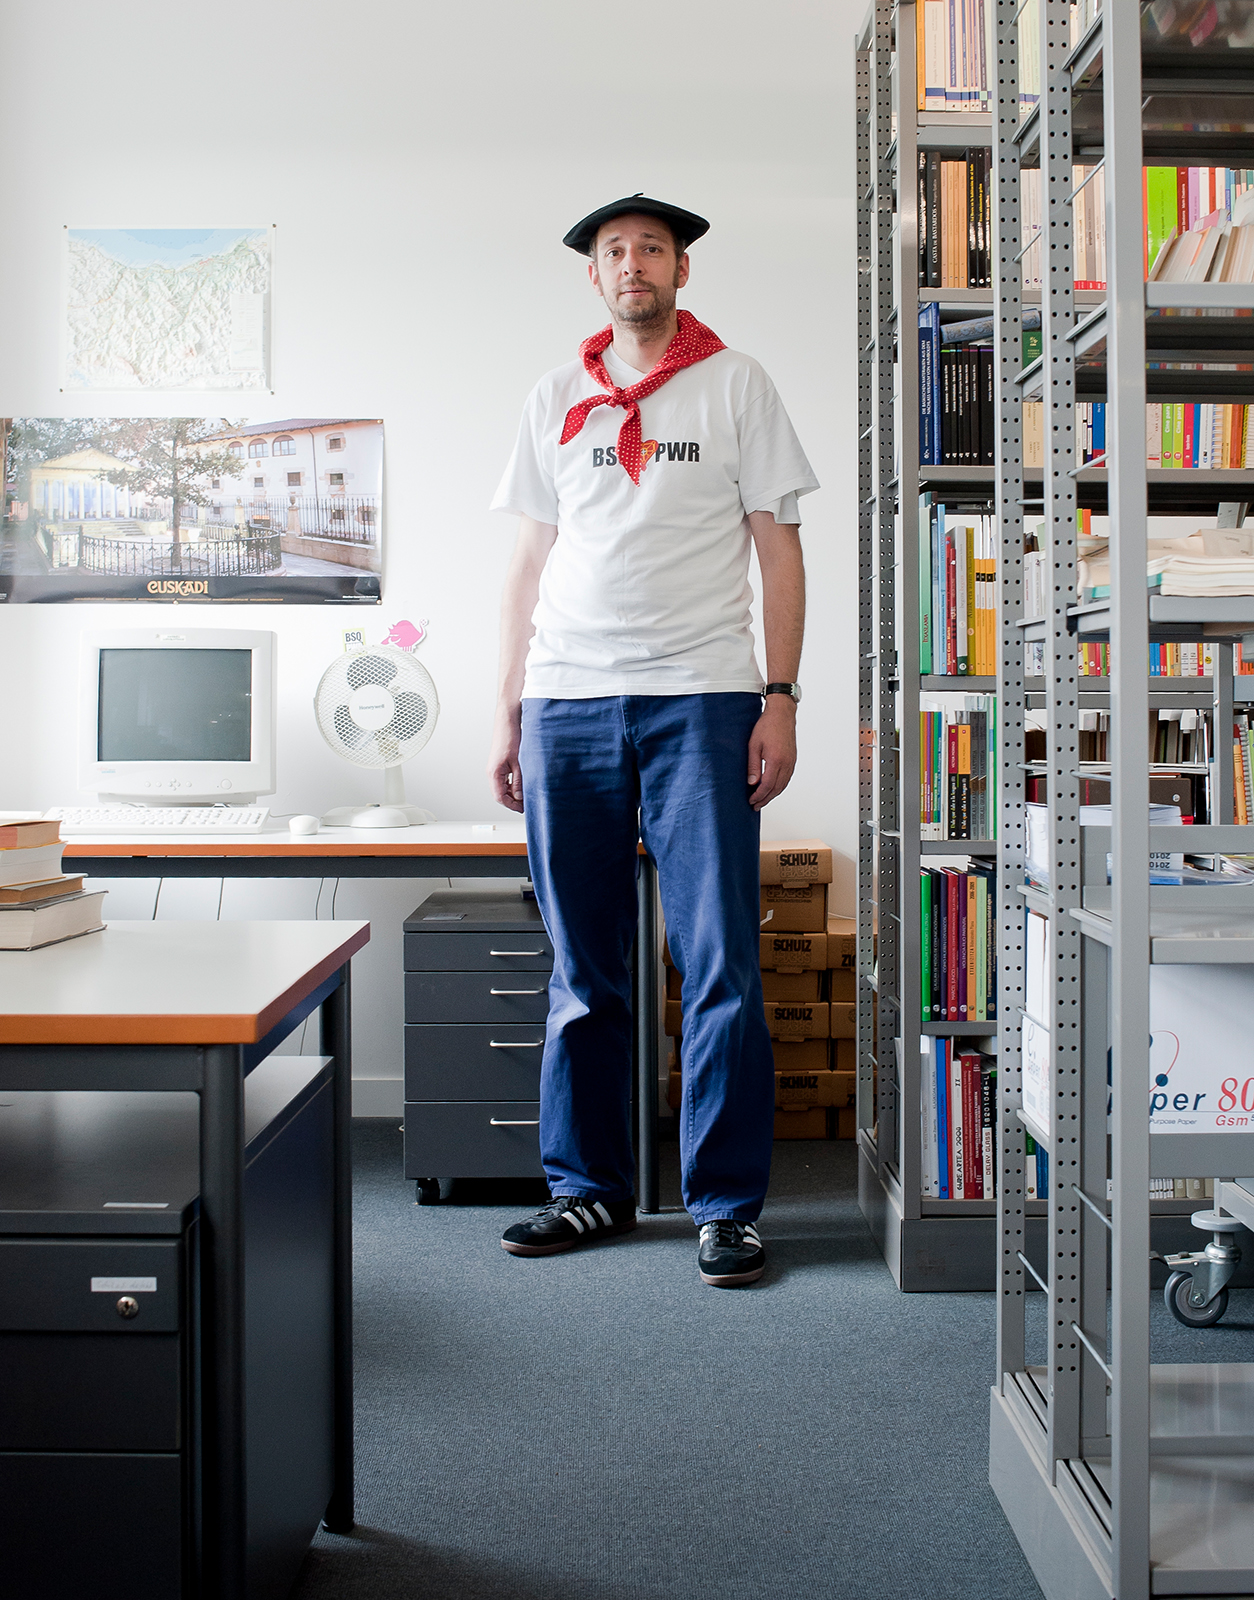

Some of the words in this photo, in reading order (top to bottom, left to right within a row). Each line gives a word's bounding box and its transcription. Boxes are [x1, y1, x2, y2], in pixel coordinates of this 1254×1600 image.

[1164, 405, 1172, 419] para
[593, 447, 618, 468] BS
[655, 441, 700, 463] PWR
[345, 631, 364, 643] BSQ
[960, 783, 968, 796] lengua
[960, 820, 968, 830] Dale
[780, 853, 818, 866] SCHULZ
[773, 939, 812, 952] SCHULZ
[774, 1007, 813, 1020] SCHULZ
[780, 1076, 818, 1089] SCHULZ
[1149, 1092, 1206, 1117] per
[1218, 1077, 1254, 1112] 80
[1215, 1114, 1248, 1126] Gsm
